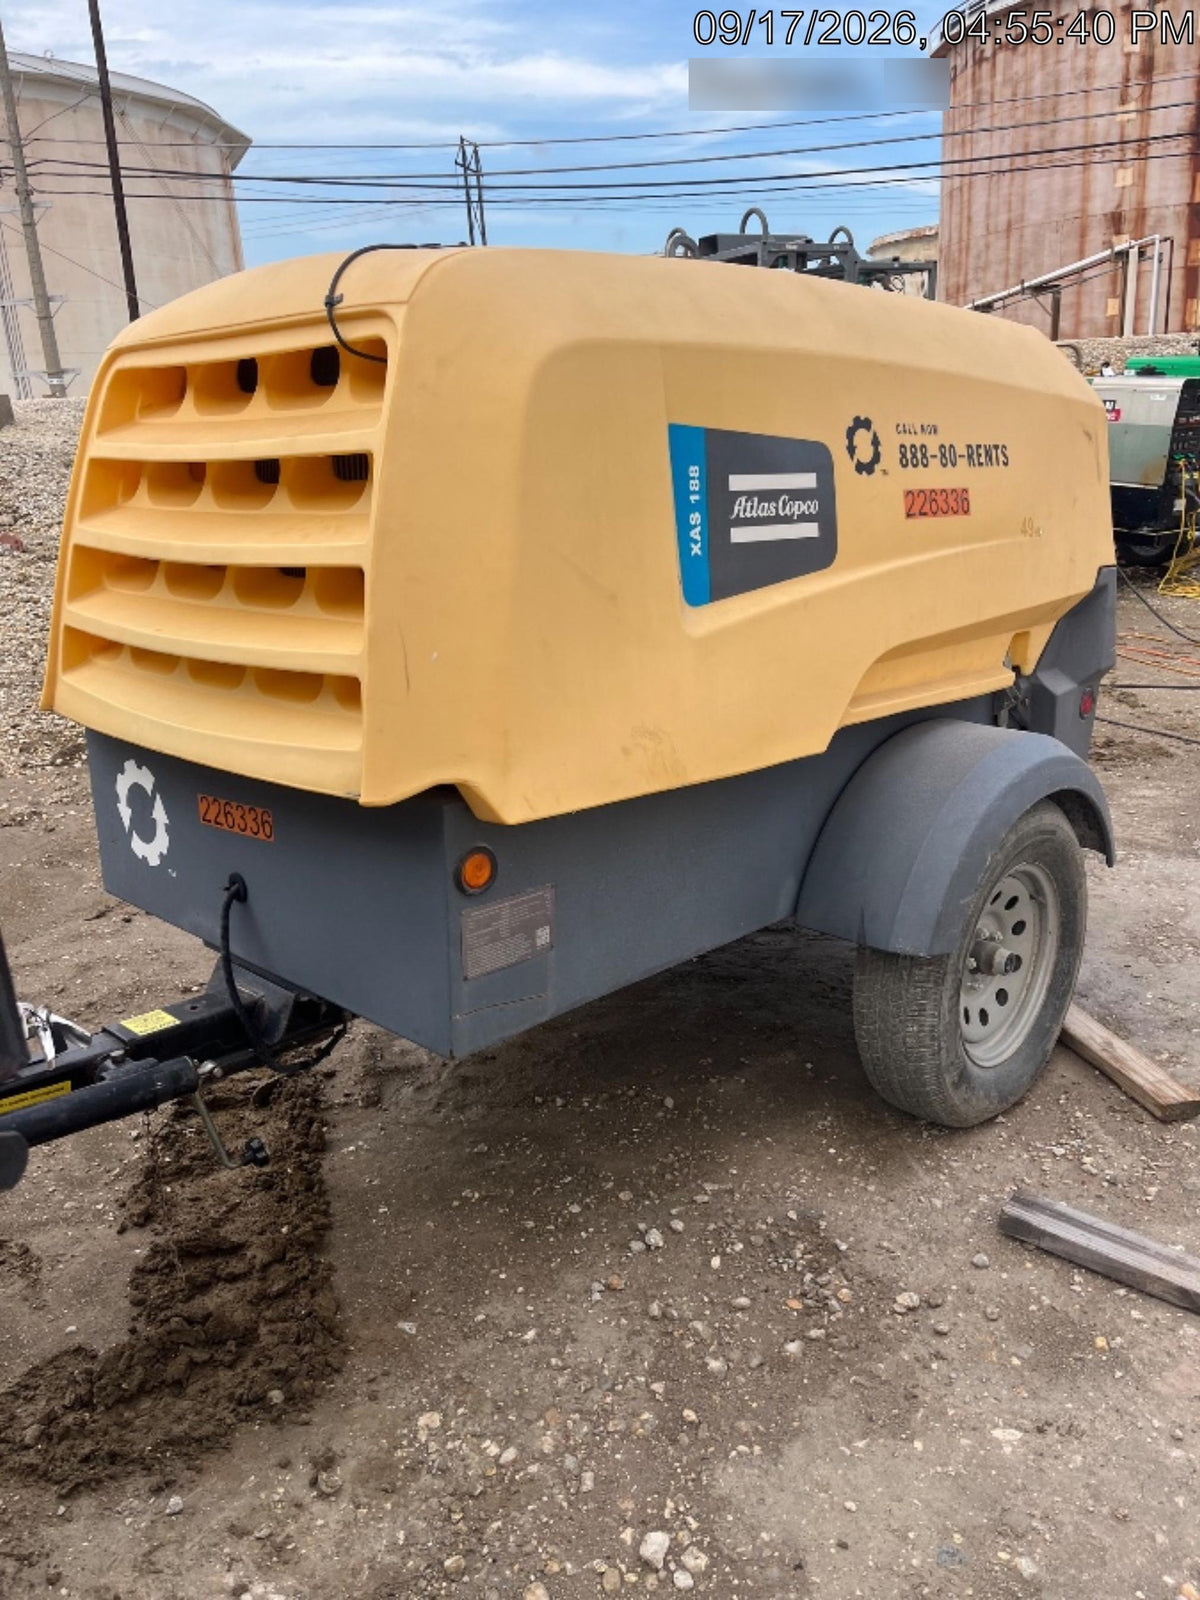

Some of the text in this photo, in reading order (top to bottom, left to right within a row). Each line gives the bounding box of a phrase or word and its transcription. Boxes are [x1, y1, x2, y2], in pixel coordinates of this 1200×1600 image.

[896, 423, 939, 435] CALL NOW
[899, 443, 1009, 468] 888-80-RENTS
[688, 465, 702, 557] XAS 188
[730, 494, 819, 520] Atlas Copco
[906, 488, 970, 518] 226336
[200, 796, 273, 839] 226336
